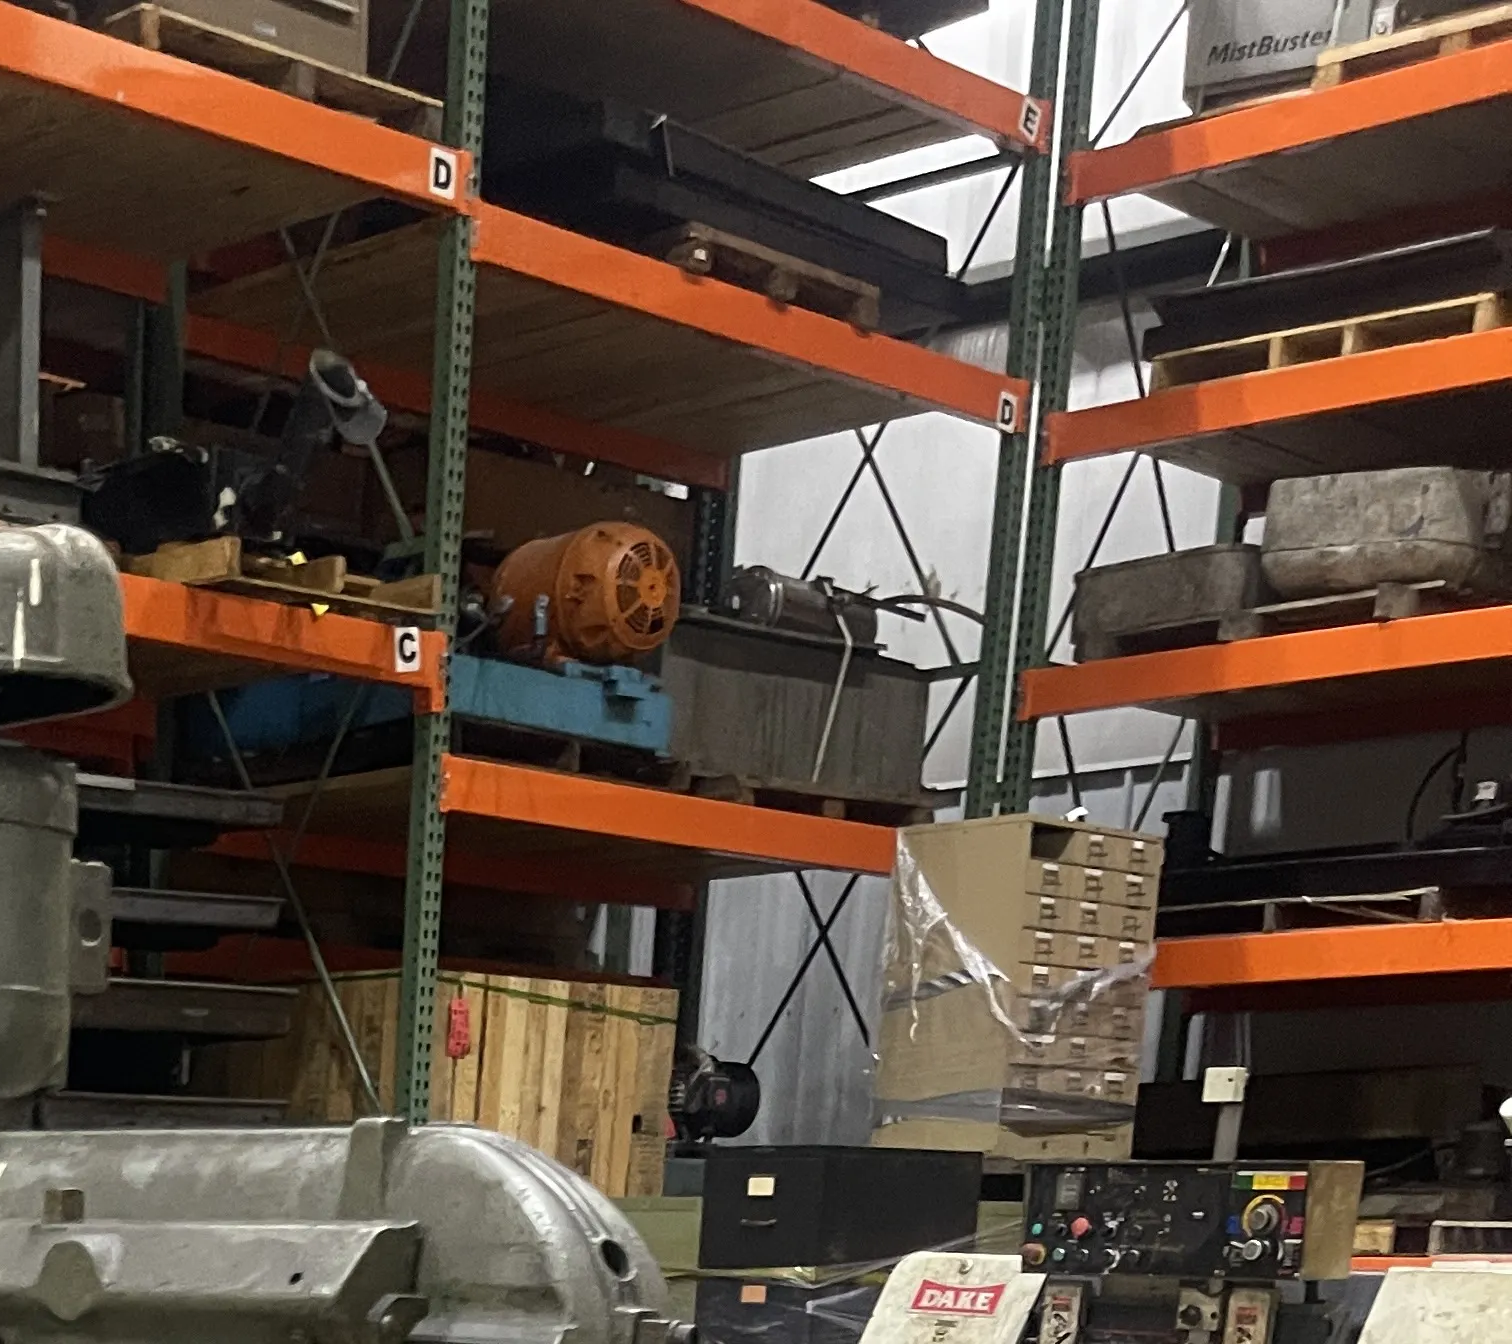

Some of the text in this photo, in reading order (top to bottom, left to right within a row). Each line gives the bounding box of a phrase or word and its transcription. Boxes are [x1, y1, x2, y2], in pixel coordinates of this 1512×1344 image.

[1207, 28, 1333, 66] MistBuster
[1023, 104, 1038, 136] E
[433, 156, 452, 190] D
[1000, 398, 1015, 426] D
[398, 632, 417, 664] C
[919, 1288, 995, 1311] DAKE
